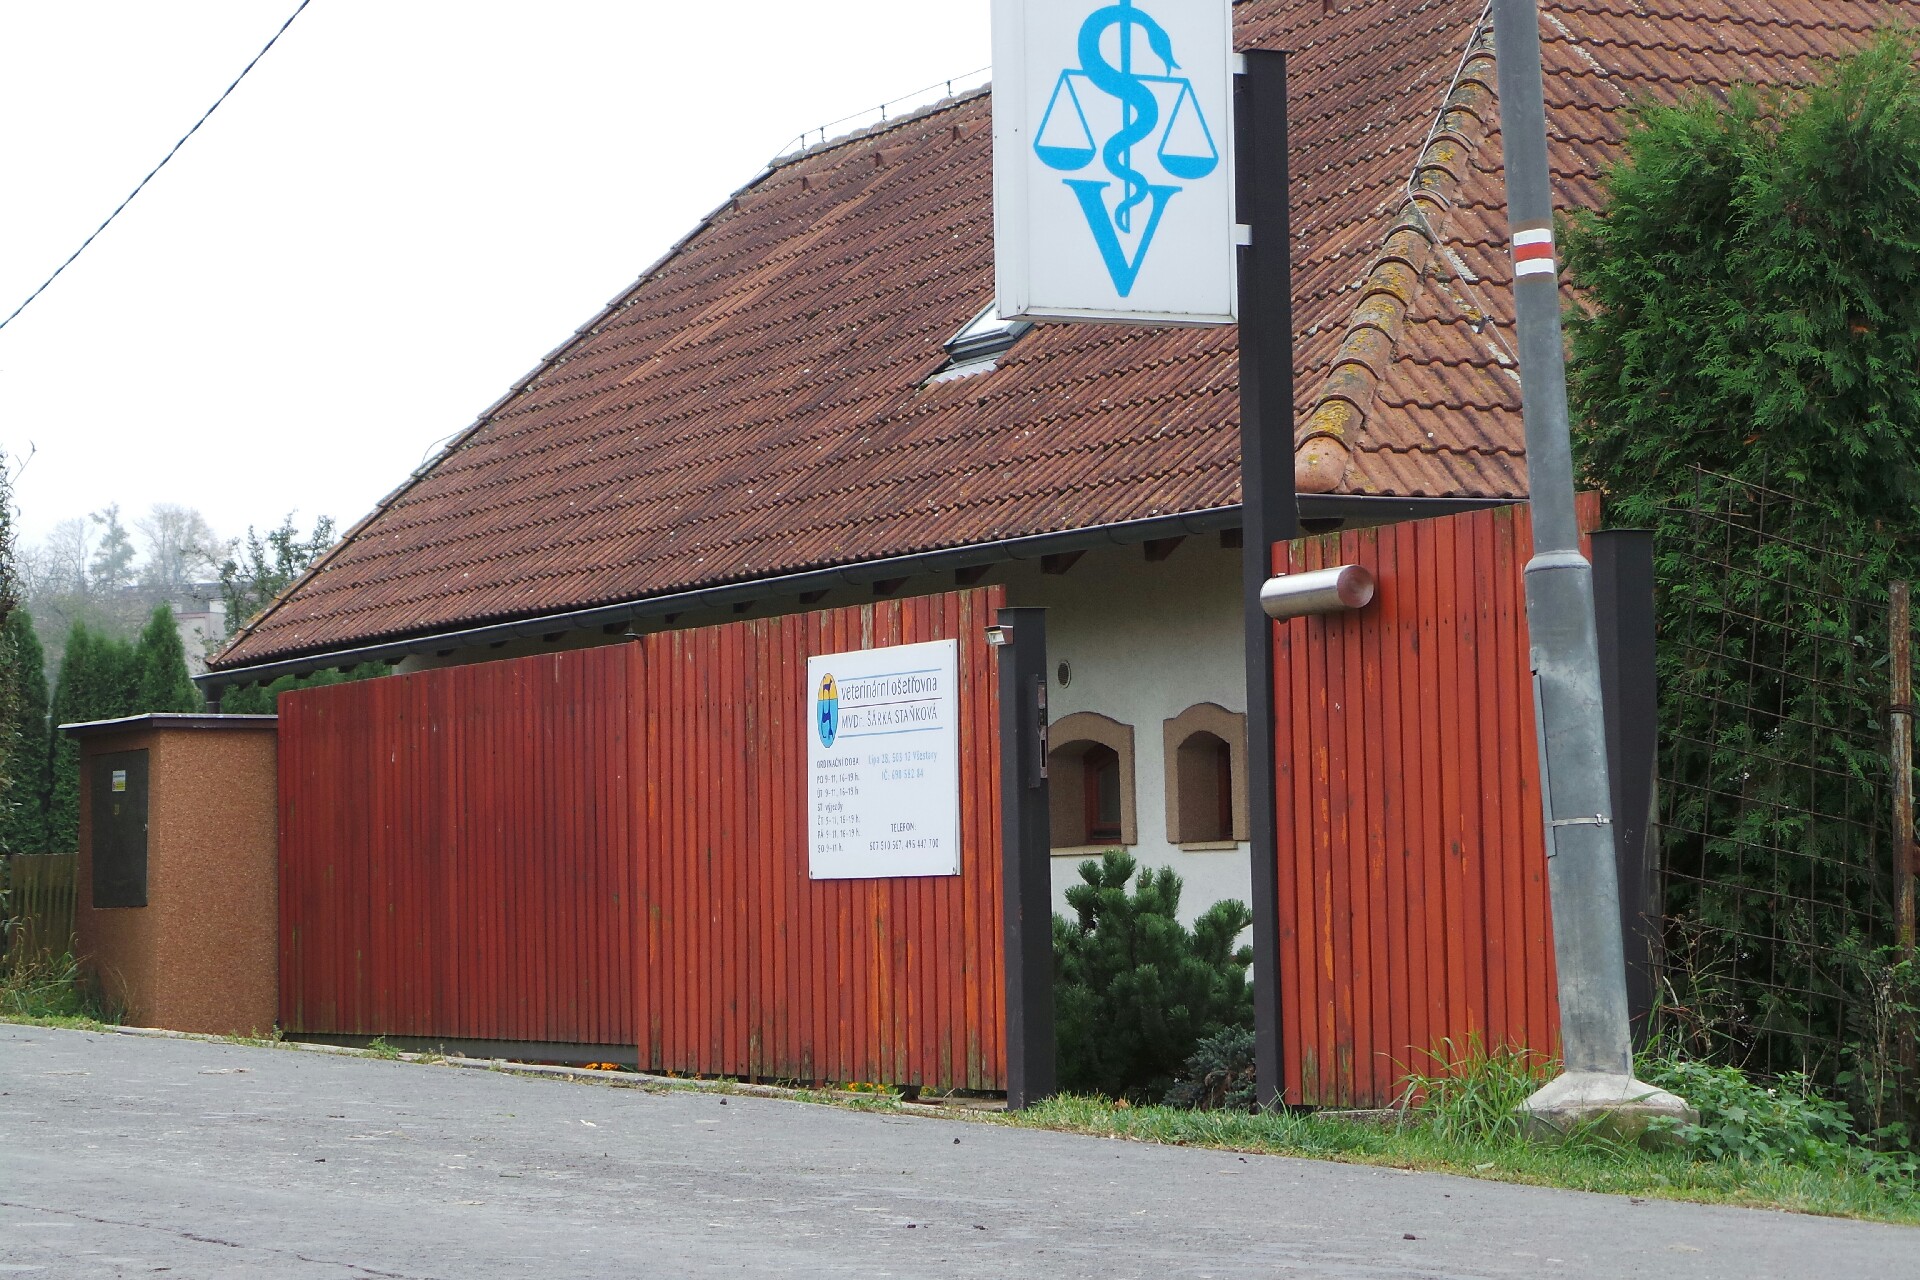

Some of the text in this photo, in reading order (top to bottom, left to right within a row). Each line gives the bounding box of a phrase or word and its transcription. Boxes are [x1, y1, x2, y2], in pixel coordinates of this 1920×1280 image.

[841, 675, 937, 701] veterinární ošetřovna
[867, 709, 893, 727] ŠÁRKA
[895, 703, 937, 724] STAŇKOVÁ
[816, 757, 859, 769] ORDINAČNÍ DOBA
[816, 775, 824, 784] PO
[817, 844, 825, 854] SO
